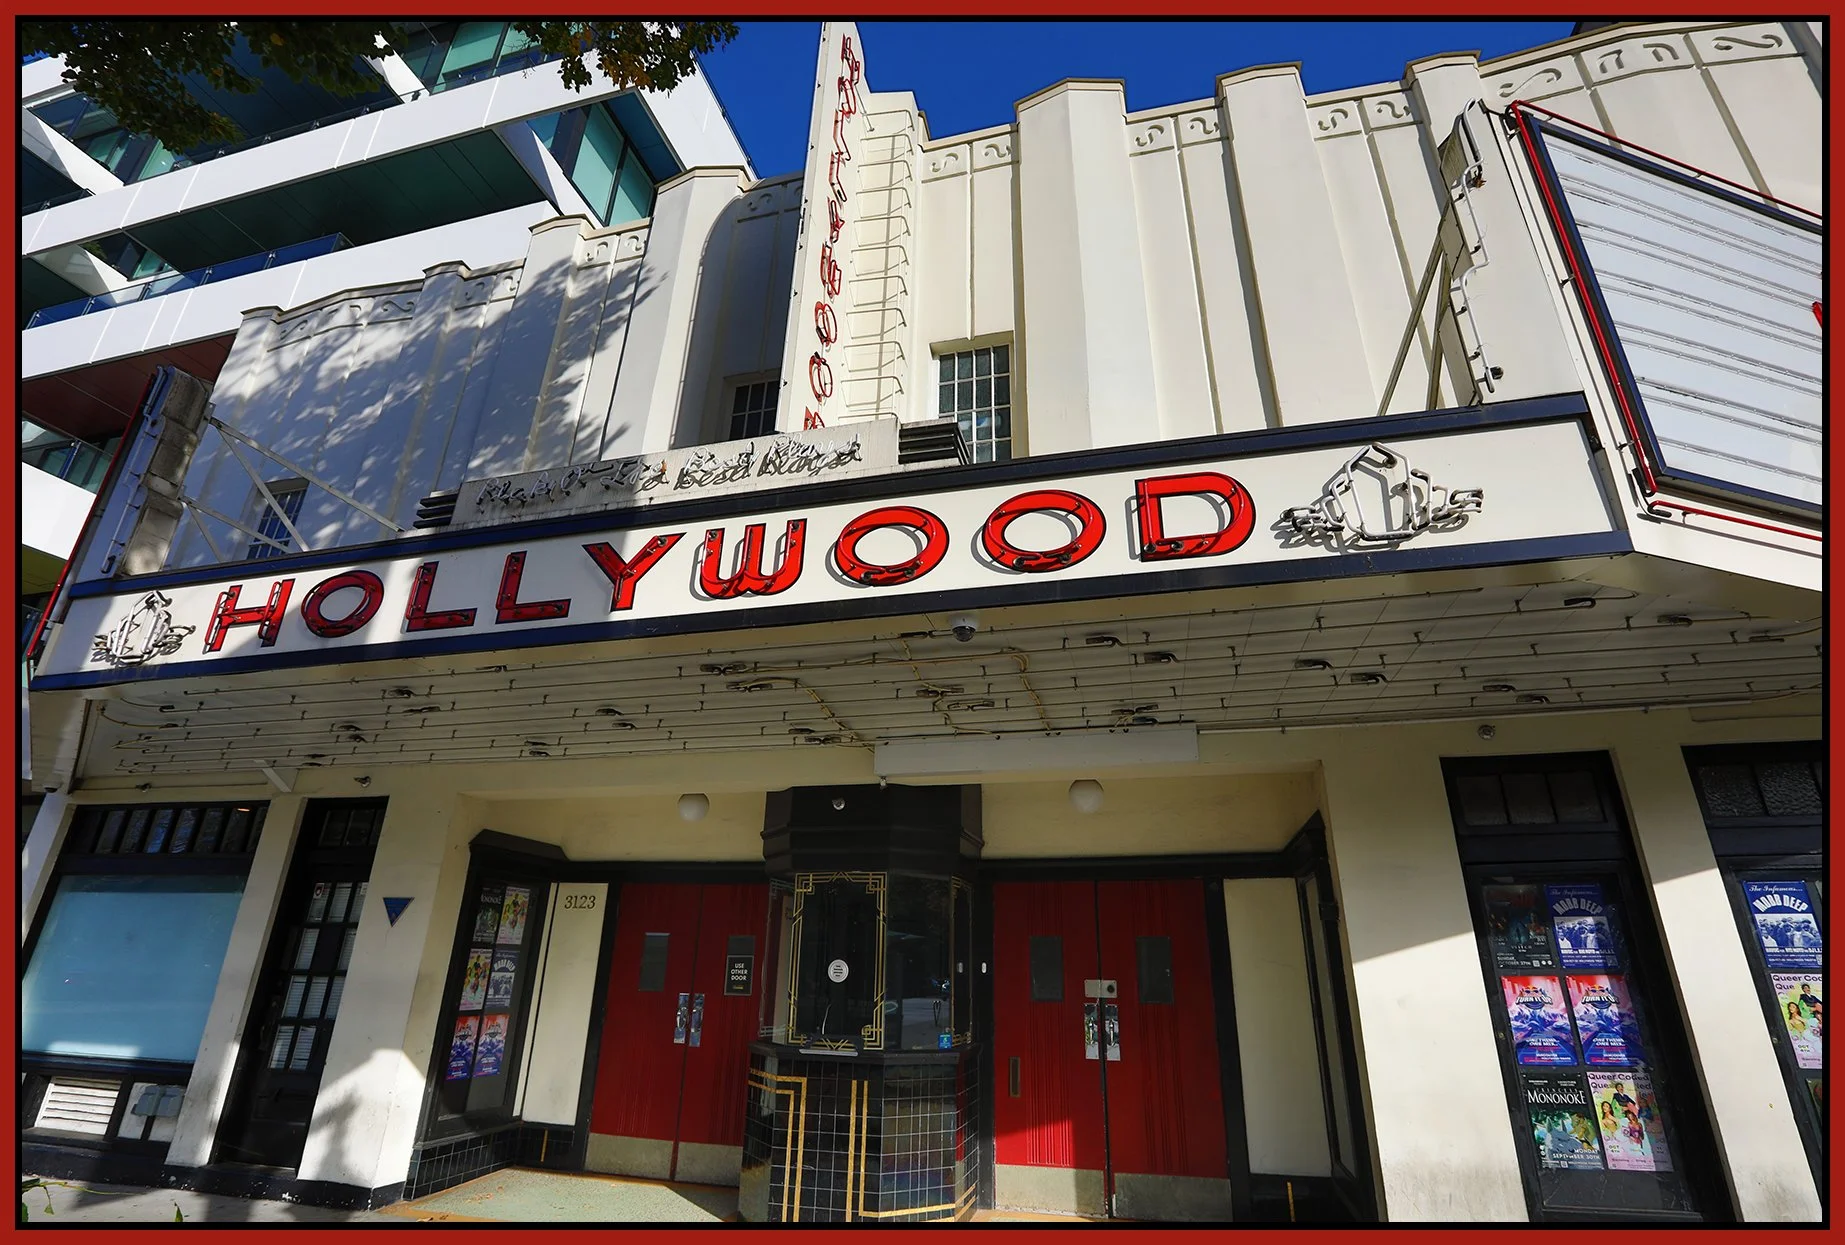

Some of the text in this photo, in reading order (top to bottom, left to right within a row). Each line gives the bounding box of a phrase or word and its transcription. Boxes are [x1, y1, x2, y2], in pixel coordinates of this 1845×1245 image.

[203, 471, 1257, 653] HOLLYWOOD
[564, 895, 596, 909] 3123
[1552, 898, 1580, 915] MOBB
[1580, 898, 1603, 915] DEEP
[1752, 894, 1809, 912] MOBB DEEP
[1773, 974, 1801, 982] Queer
[1588, 1073, 1617, 1081] Queer
[1527, 1089, 1587, 1105] MONONOKE
